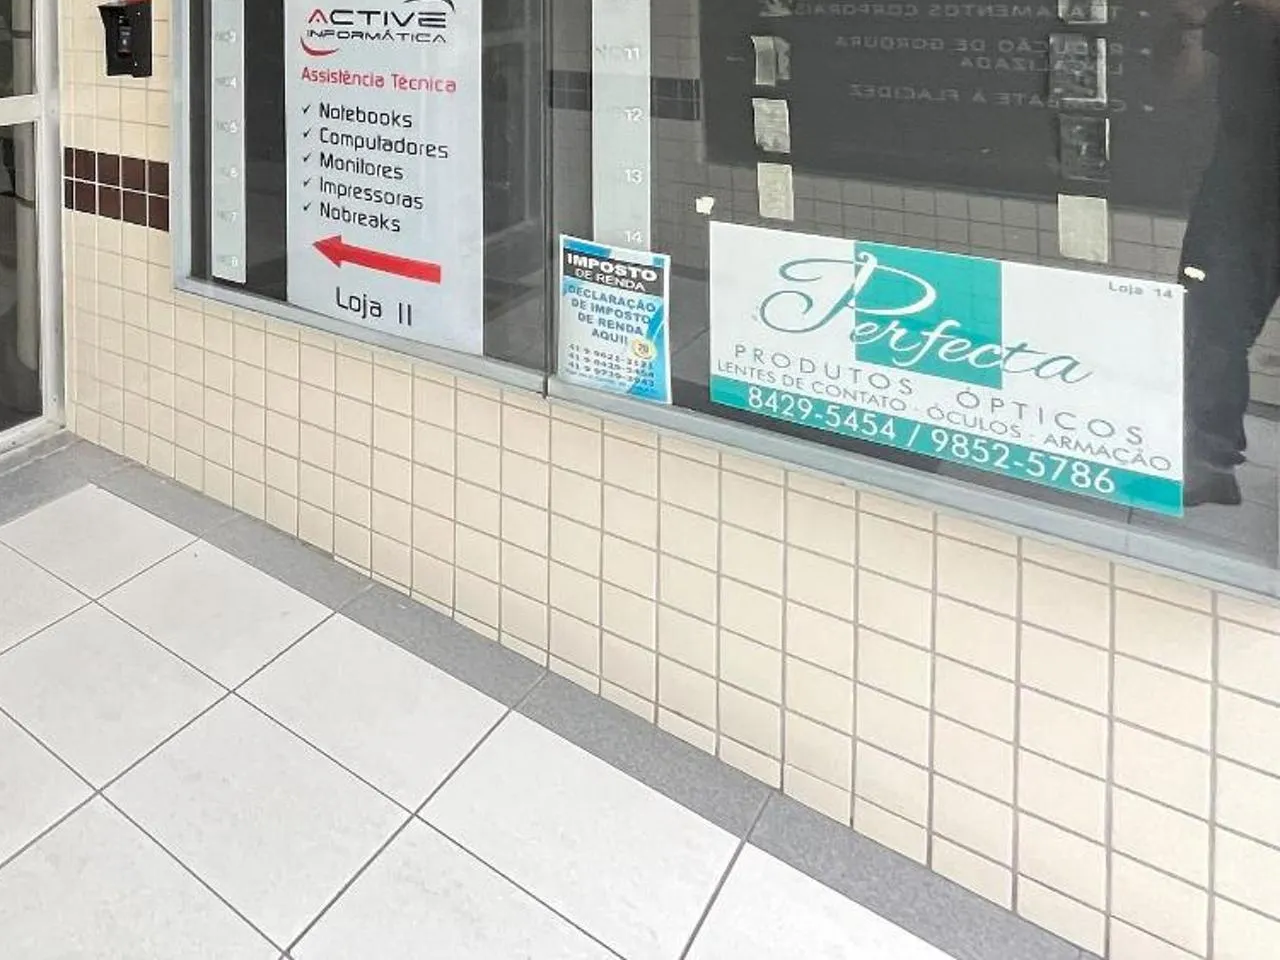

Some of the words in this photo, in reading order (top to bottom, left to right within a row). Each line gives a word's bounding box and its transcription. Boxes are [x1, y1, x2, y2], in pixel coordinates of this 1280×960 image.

[308, 8, 446, 29] ACTIVE
[307, 29, 447, 44] INFORMÁTICA
[624, 46, 641, 61] 11
[319, 102, 413, 128] Notebooks
[624, 108, 644, 122] 12
[319, 127, 449, 159] Computadores
[319, 152, 404, 180] Monitores
[624, 169, 643, 185] 13
[319, 177, 424, 210] Impressoras
[319, 202, 401, 232] Nobreaks
[624, 230, 643, 244] 14
[567, 253, 658, 281] IMPOSTO
[575, 268, 593, 280] DE
[596, 275, 646, 292] RENDA
[335, 286, 383, 319] Loja
[568, 284, 656, 313] DECLARAÇÃO
[1153, 288, 1173, 299] 14
[571, 298, 587, 310] DE
[590, 302, 651, 325] IMPOSTO
[578, 312, 594, 325] DE
[598, 317, 643, 336] RENDA
[760, 250, 1093, 384] Perfecta
[734, 344, 913, 396] PRODUTOS
[956, 386, 1143, 445] ÓPTICOS
[717, 359, 776, 384] LENTES
[782, 373, 804, 389] DE
[811, 380, 907, 412] CONTATO
[926, 404, 1022, 439] ÓCULOS
[1044, 432, 1172, 471] ARMAÇÃO
[748, 386, 897, 441] 8429-5454
[907, 424, 921, 448] /
[931, 428, 1115, 493] 9852-5786
